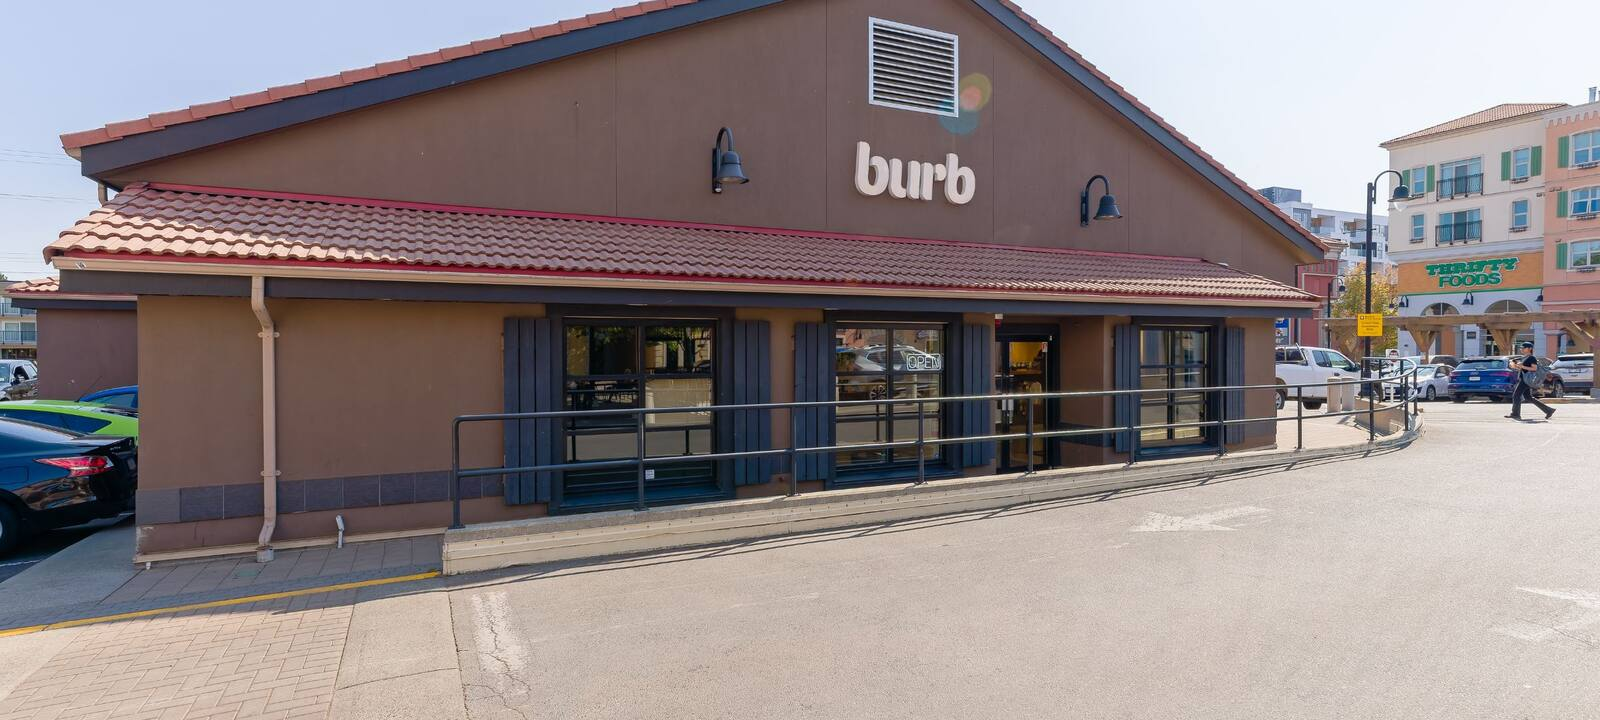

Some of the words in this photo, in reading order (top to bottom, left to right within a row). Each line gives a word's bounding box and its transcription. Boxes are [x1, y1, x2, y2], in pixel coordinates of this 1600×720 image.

[855, 141, 976, 205] burb
[1425, 257, 1519, 276] THRIFTY
[1438, 272, 1503, 288] FOODS
[908, 355, 940, 369] OPEN
